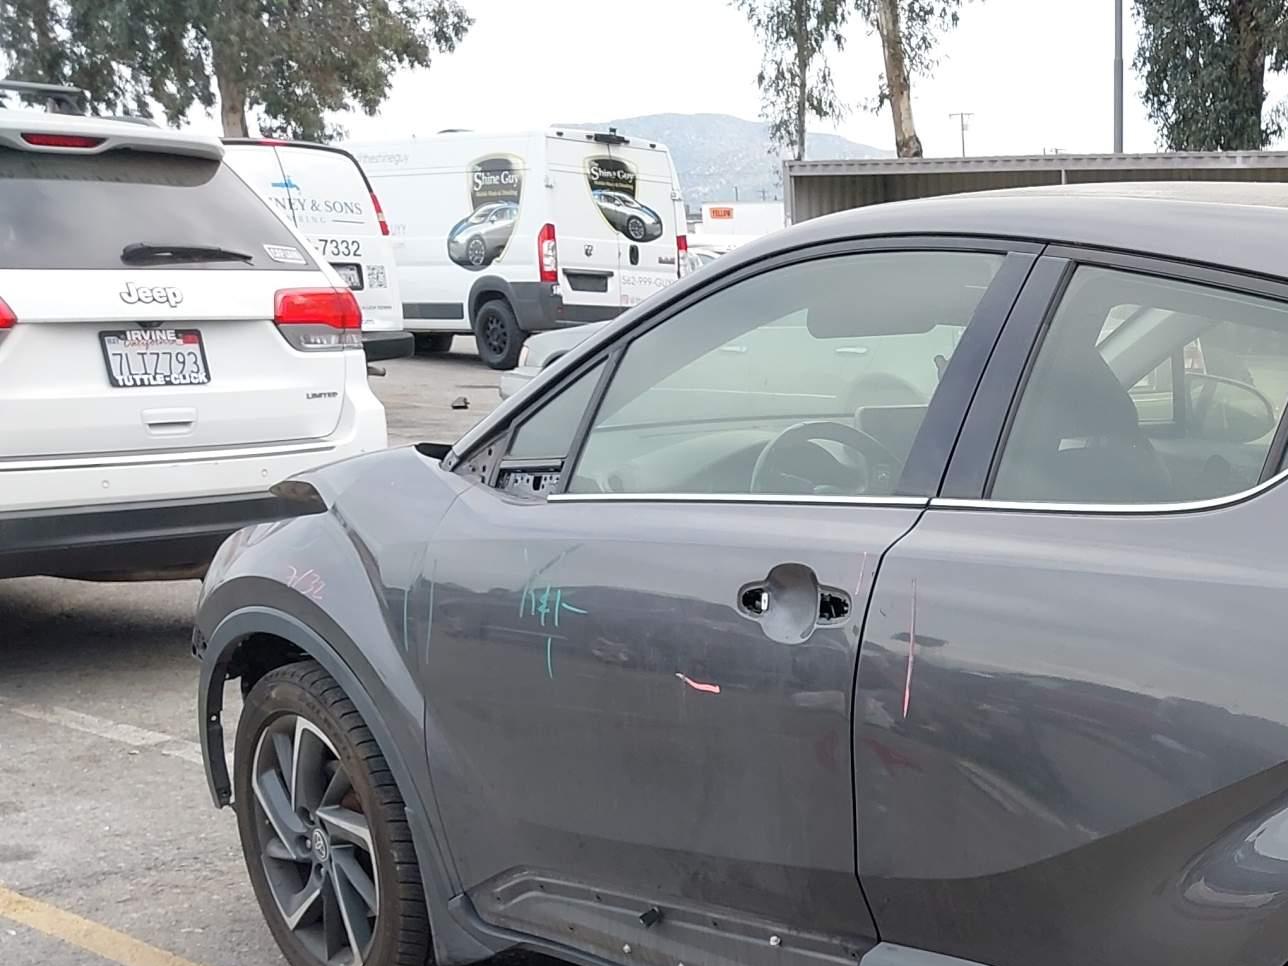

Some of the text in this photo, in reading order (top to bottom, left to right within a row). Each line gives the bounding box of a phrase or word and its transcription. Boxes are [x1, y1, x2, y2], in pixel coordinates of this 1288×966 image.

[473, 171, 519, 191] Shine Guy
[590, 166, 634, 183] Shine Guy
[310, 199, 320, 212] &
[324, 200, 363, 215] SONS
[119, 281, 184, 308] Jeep
[125, 330, 177, 341] IRVINE
[111, 351, 201, 376] 7LIZ793
[306, 391, 339, 400] LIMITED
